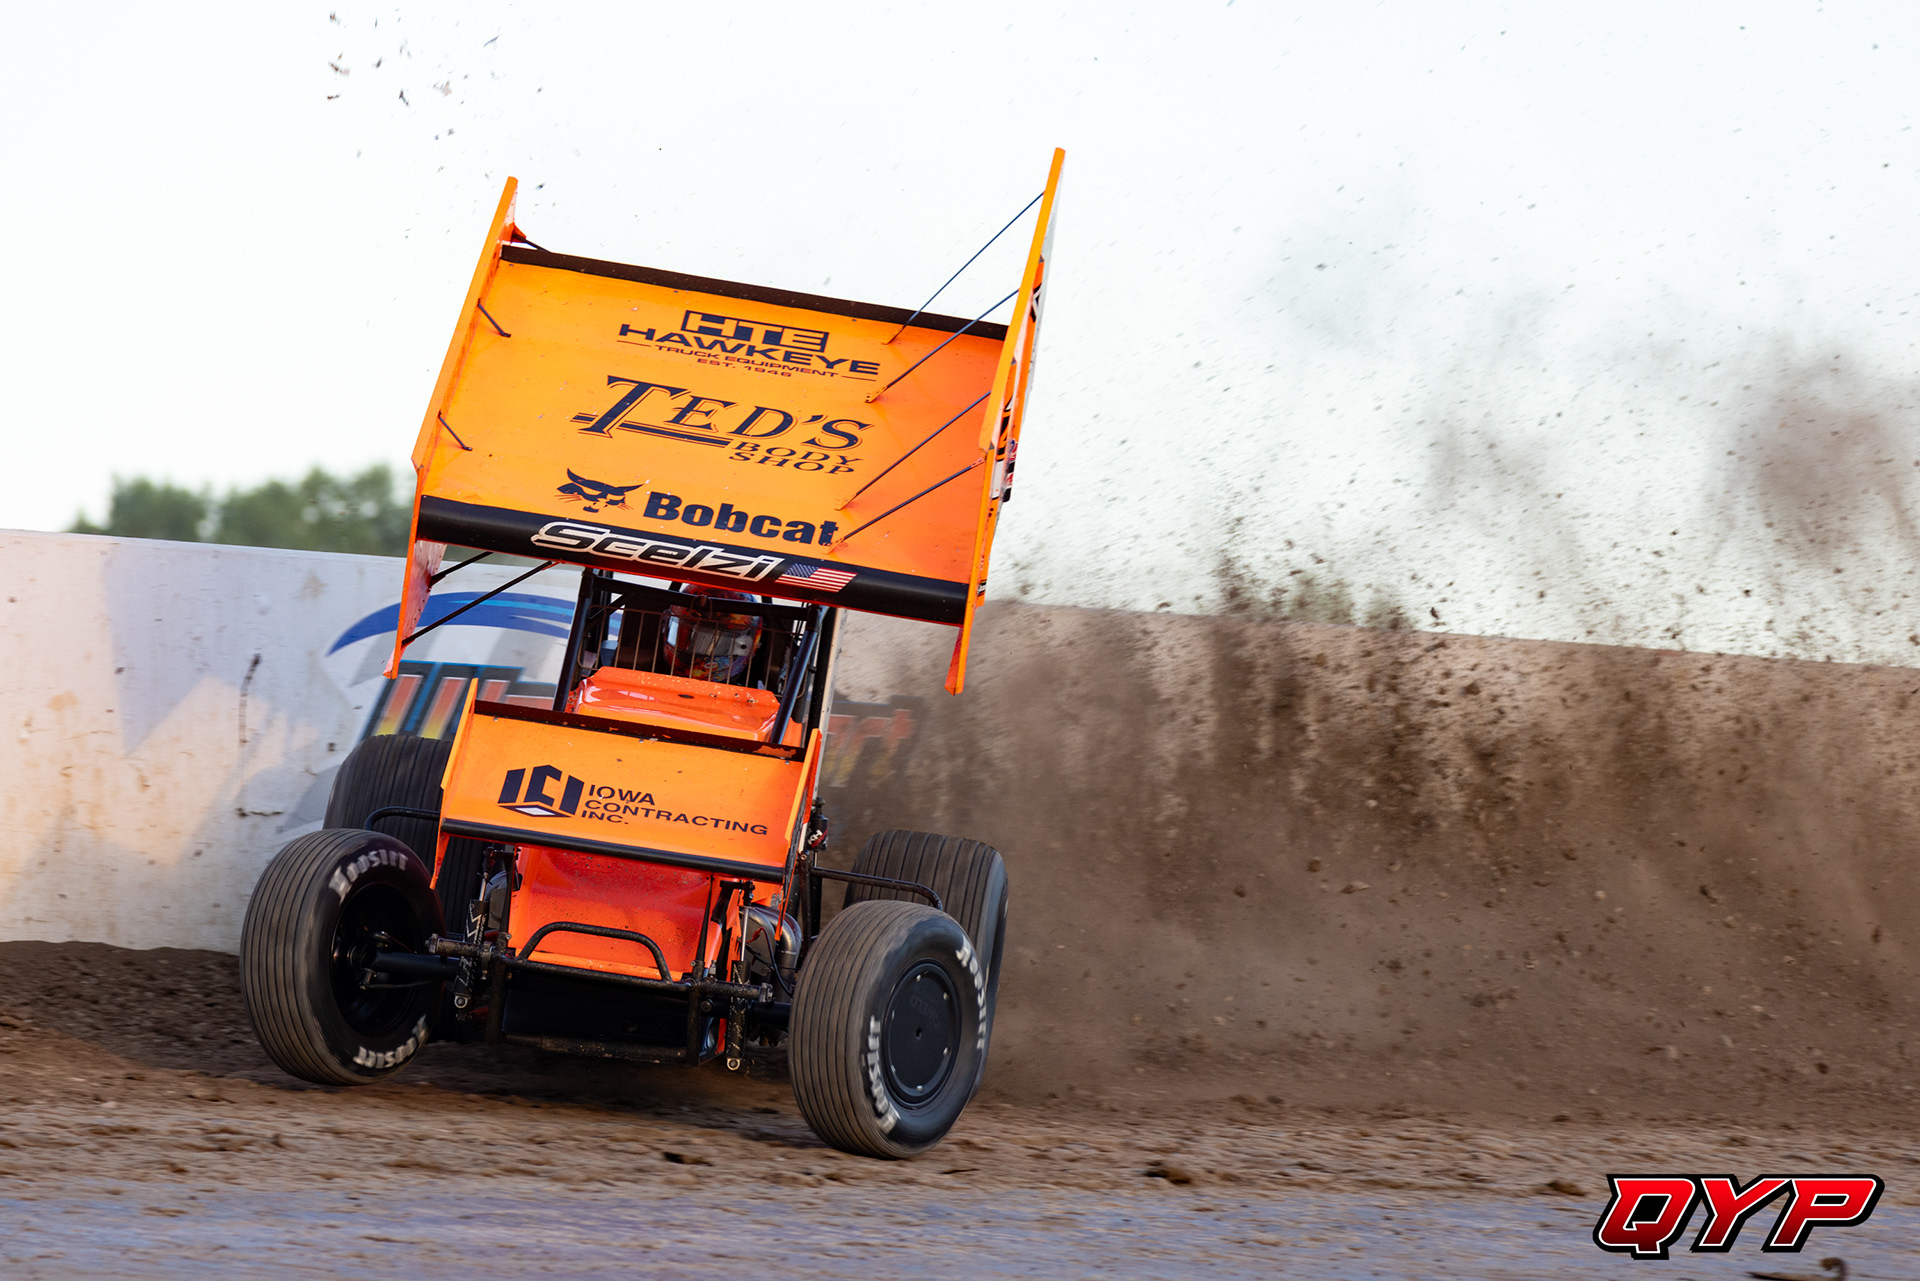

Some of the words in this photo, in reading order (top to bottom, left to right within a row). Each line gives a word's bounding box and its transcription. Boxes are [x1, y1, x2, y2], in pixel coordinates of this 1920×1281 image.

[681, 311, 829, 352] HTE
[619, 324, 881, 375] HAWKEYE
[655, 344, 719, 360] TRUCK
[725, 355, 839, 378] EQUIPMENT
[697, 358, 736, 369] EST.
[729, 452, 855, 475] SHOP
[732, 441, 863, 466] BODY
[643, 491, 839, 547] Bobcat
[531, 521, 785, 582] Scelzi
[588, 784, 656, 806] IOWA
[581, 810, 629, 825] INC.
[584, 800, 768, 836] CONTRACTING
